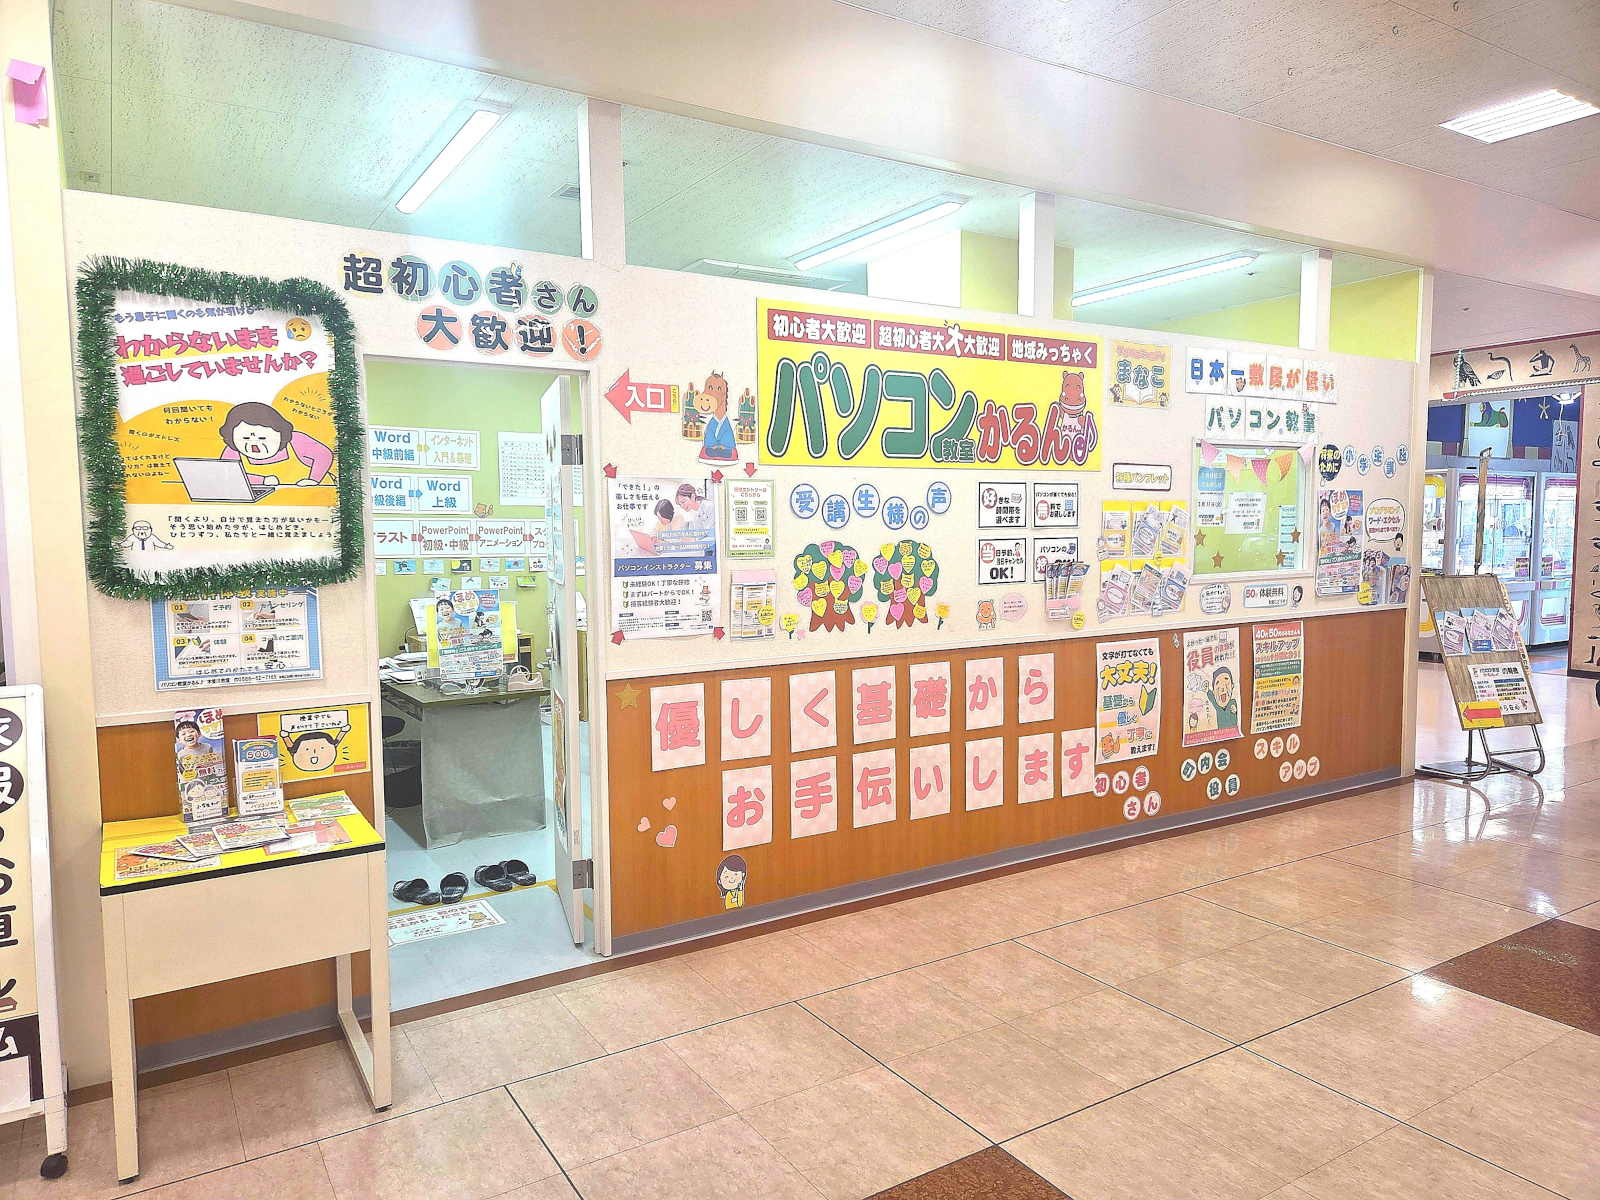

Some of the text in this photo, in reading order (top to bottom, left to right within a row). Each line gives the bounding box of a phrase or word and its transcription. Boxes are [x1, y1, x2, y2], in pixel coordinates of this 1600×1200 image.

[343, 253, 595, 313] 超初心者さん
[773, 313, 867, 345] 初心者大歓迎
[115, 326, 279, 360] わからないまま
[1011, 341, 1093, 366] 地域みっちゃく
[1116, 359, 1165, 389] まなこ
[1190, 358, 1335, 392] 日本一敷居が低い
[624, 385, 665, 409] 入口
[1208, 406, 1316, 433] パソコン教室
[375, 431, 411, 443] Word
[430, 435, 474, 447] インターネット
[372, 448, 415, 461] 中級前編
[426, 480, 461, 492] Word
[431, 496, 457, 508] 上級
[615, 493, 660, 501] 楽しさを伝える
[796, 487, 948, 525] 受講生様の声
[374, 531, 408, 543] ラスト
[421, 526, 469, 536] PowerPoint
[478, 526, 523, 536] PowerPoint
[479, 539, 523, 548] アニメーション
[1040, 546, 1067, 554] パソコンの
[617, 563, 692, 572] パソコンインストラクター
[989, 566, 1014, 580] OK!
[1101, 648, 1154, 660] 文字が打てなくても
[1255, 638, 1301, 654] スキルアップ
[1186, 646, 1215, 672] 役員
[655, 669, 1050, 752] 優しく基礎から
[1102, 694, 1136, 711] 基礎から
[1256, 737, 1299, 755] スキル
[1183, 752, 1228, 778] 町内会
[1281, 759, 1318, 778] アップ
[727, 743, 1090, 829] お手伝いします
[1095, 771, 1147, 794] 初心者
[1209, 777, 1237, 797] 役員
[1127, 796, 1158, 816] さん
